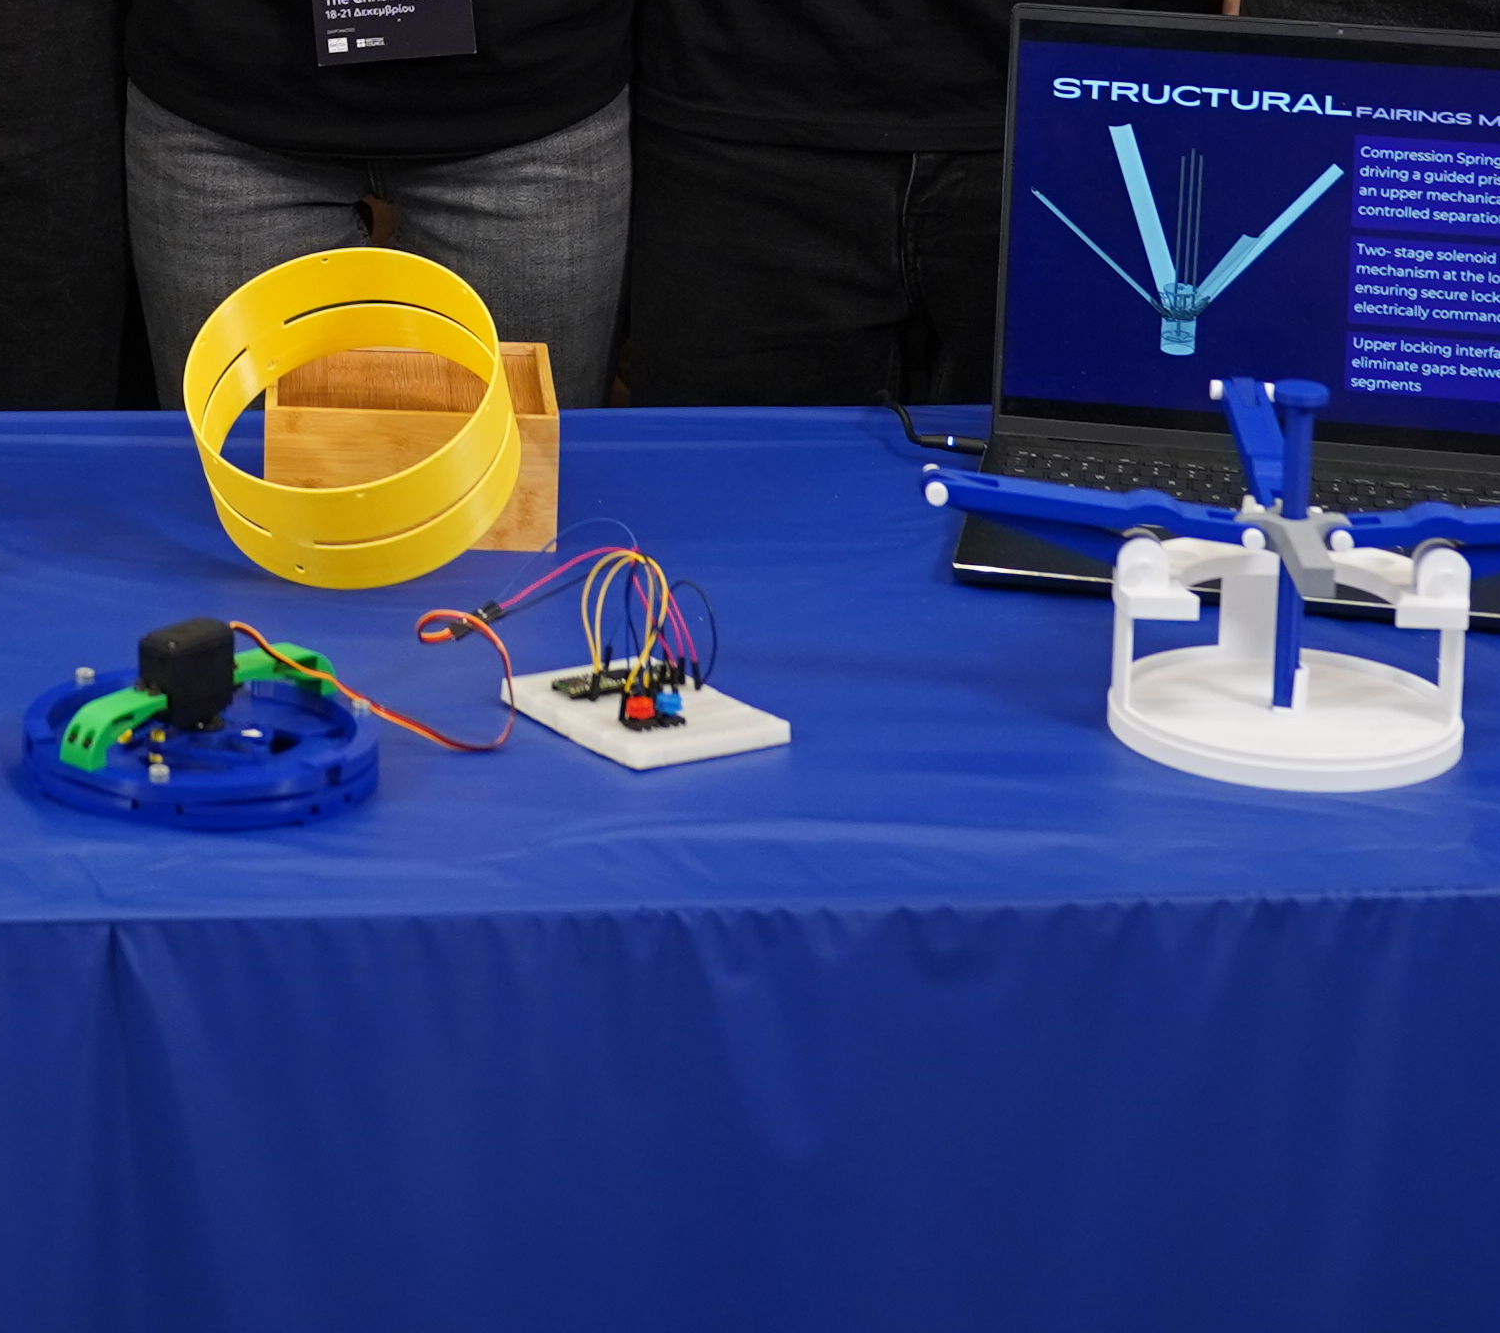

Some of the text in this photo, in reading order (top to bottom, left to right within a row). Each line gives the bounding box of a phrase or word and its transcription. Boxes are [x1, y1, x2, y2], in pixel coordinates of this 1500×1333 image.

[325, 4, 416, 20] 18-21 Δεκεμβρίου
[1053, 76, 1352, 118] STRUCTURAL
[1355, 105, 1472, 127] FAIRINGS
[1360, 145, 1454, 164] Compression
[1359, 165, 1409, 182] driving
[1412, 171, 1420, 181] a
[1424, 169, 1474, 184] guided
[1358, 185, 1377, 197] an
[1380, 186, 1424, 201] upper
[1357, 204, 1430, 220] controlled
[1356, 242, 1391, 256] Two-
[1394, 247, 1434, 262] stage
[1436, 249, 1497, 265] solenoid
[1356, 263, 1440, 280] mechanism
[1442, 270, 1457, 281] at
[1460, 270, 1485, 283] the
[1354, 283, 1418, 300] ensuring
[1420, 288, 1468, 302] secure
[1353, 302, 1429, 320] electrically
[1352, 336, 1397, 352] Upper
[1399, 339, 1452, 358] locking
[1351, 356, 1418, 372] eliminate
[1421, 363, 1457, 376] gaps
[1350, 376, 1422, 392] segments
